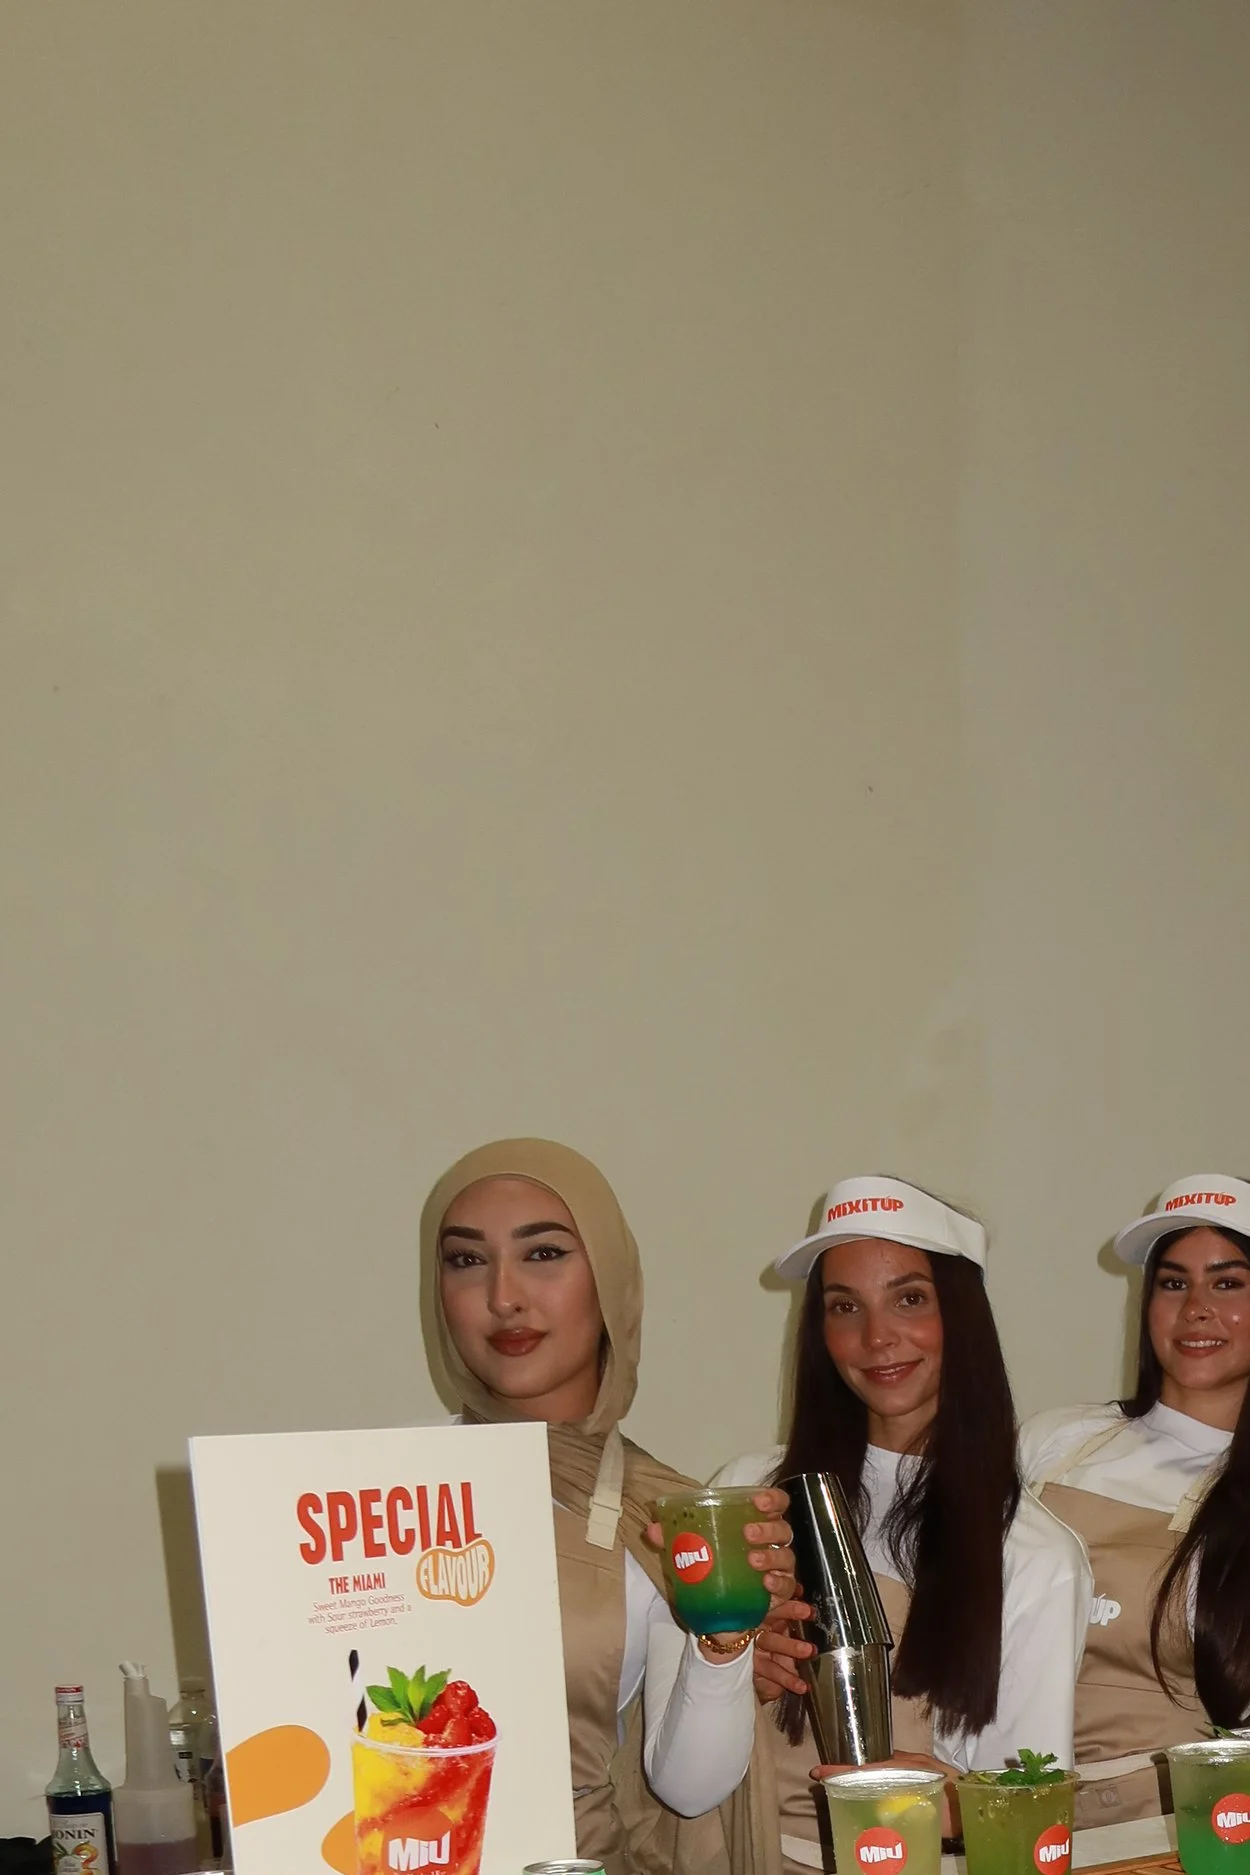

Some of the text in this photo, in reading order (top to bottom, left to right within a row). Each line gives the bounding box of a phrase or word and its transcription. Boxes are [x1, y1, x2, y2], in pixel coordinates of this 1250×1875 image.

[296, 1482, 483, 1565] SPECIAL
[421, 1544, 489, 1600] FLAVOUR
[328, 1572, 386, 1595] THE MIAMI
[308, 1613, 325, 1624] with
[327, 1612, 346, 1622] Sour
[348, 1607, 389, 1620] strawberry
[391, 1603, 405, 1613] and
[313, 1593, 405, 1612] Sweet Mango Goodness
[324, 1622, 358, 1635] squeeze
[359, 1619, 368, 1629] of
